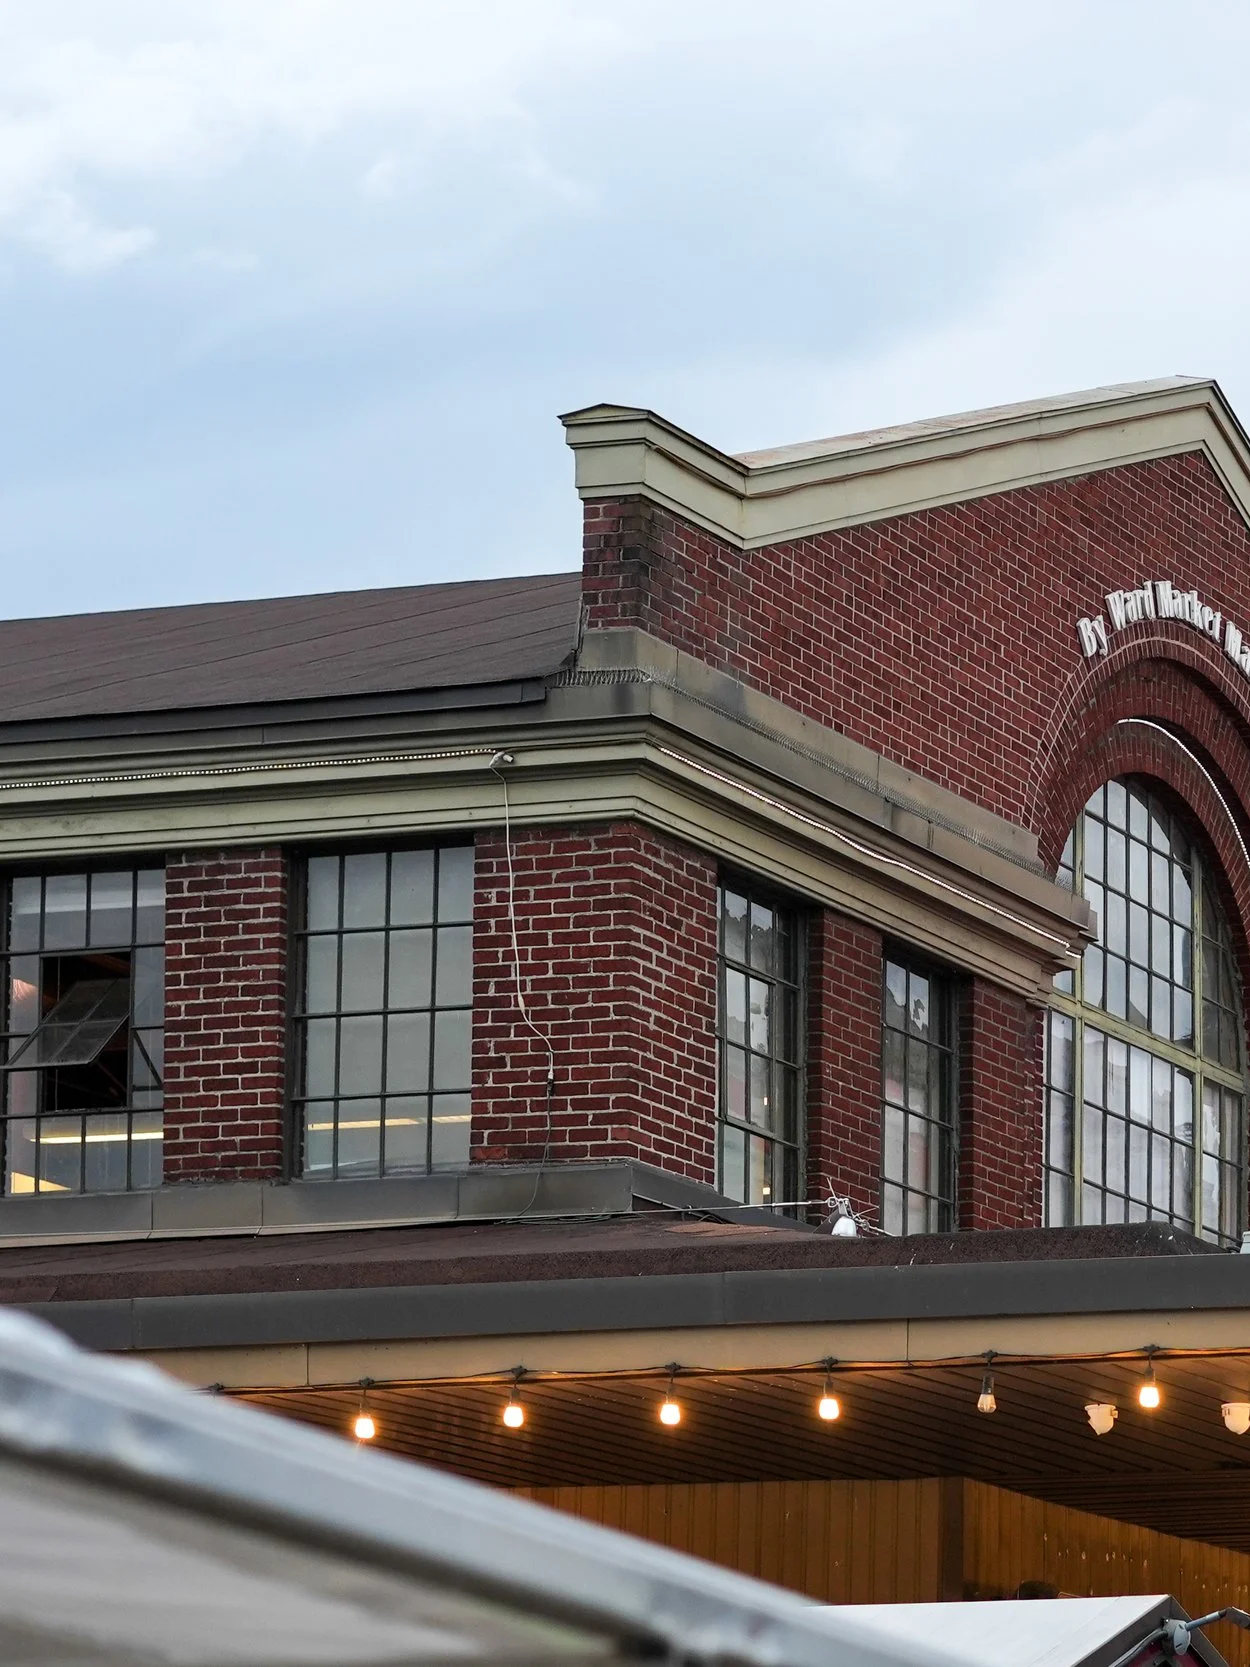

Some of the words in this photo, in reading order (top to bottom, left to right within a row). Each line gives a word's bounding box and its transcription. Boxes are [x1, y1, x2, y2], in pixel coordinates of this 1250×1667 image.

[1076, 615, 1108, 657] By
[1105, 580, 1156, 630] Ward
[1154, 580, 1222, 643] Market
